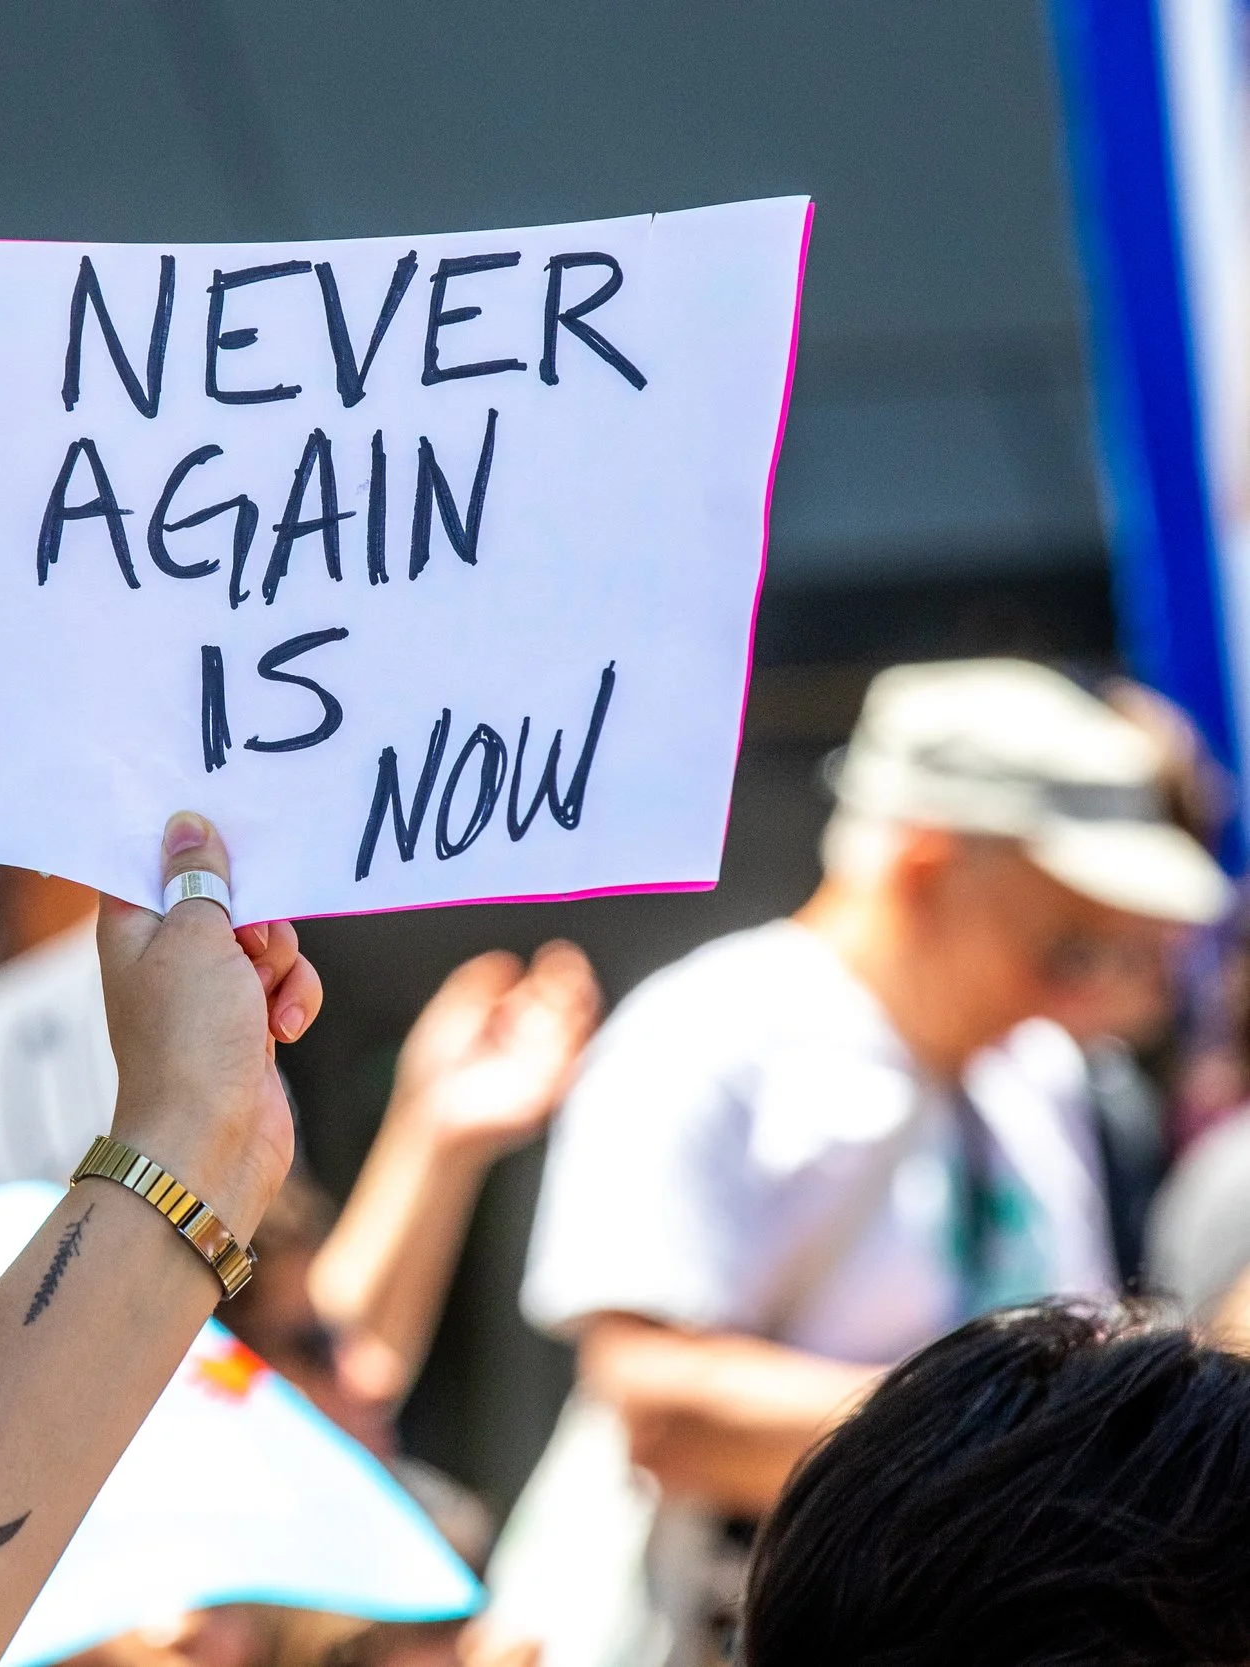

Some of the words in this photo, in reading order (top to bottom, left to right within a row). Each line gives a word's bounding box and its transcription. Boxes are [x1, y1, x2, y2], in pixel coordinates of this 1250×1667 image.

[60, 249, 648, 420] NEVER
[36, 407, 499, 611] AGAIN
[200, 626, 350, 774] IS
[354, 659, 616, 883] NOW
[190, 1211, 211, 1234] CASIO
